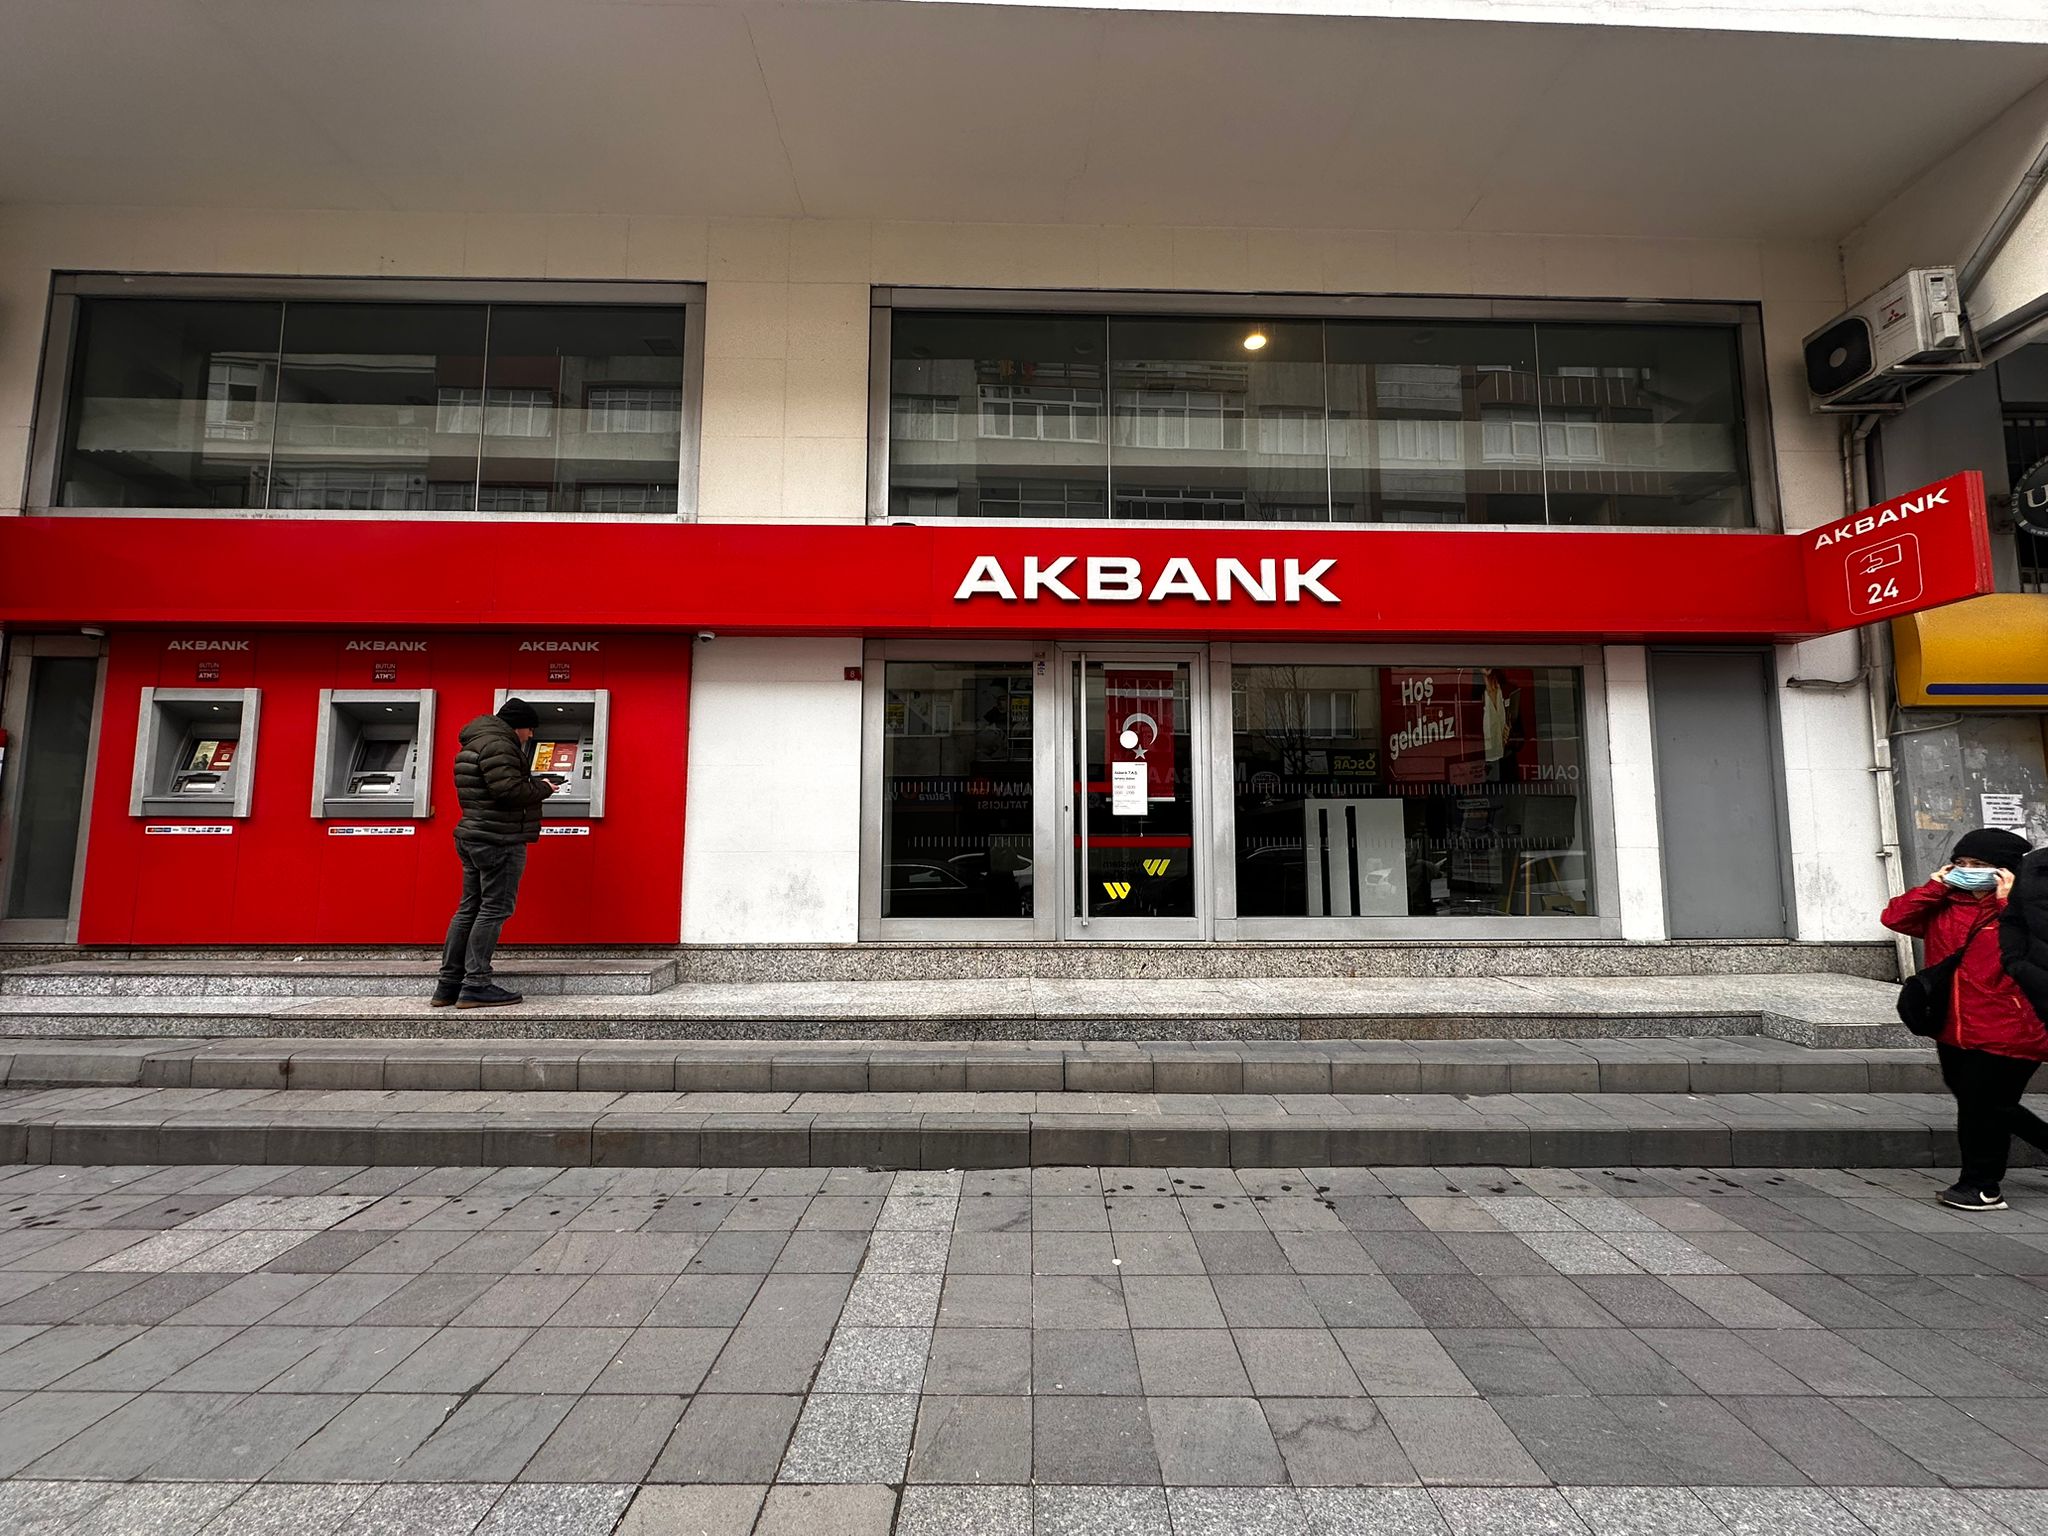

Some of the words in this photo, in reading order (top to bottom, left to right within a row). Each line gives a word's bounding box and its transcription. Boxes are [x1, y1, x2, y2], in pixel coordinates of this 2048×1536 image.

[1815, 488, 1950, 550] AKBANK
[953, 555, 1342, 602] AKBANK
[1867, 577, 1899, 605] 24
[168, 641, 249, 650] AKBANK
[345, 641, 427, 652] AKBANK
[519, 642, 600, 652] AKBANK
[1401, 677, 1434, 706] Hoş
[1389, 709, 1455, 760] geldiniz
